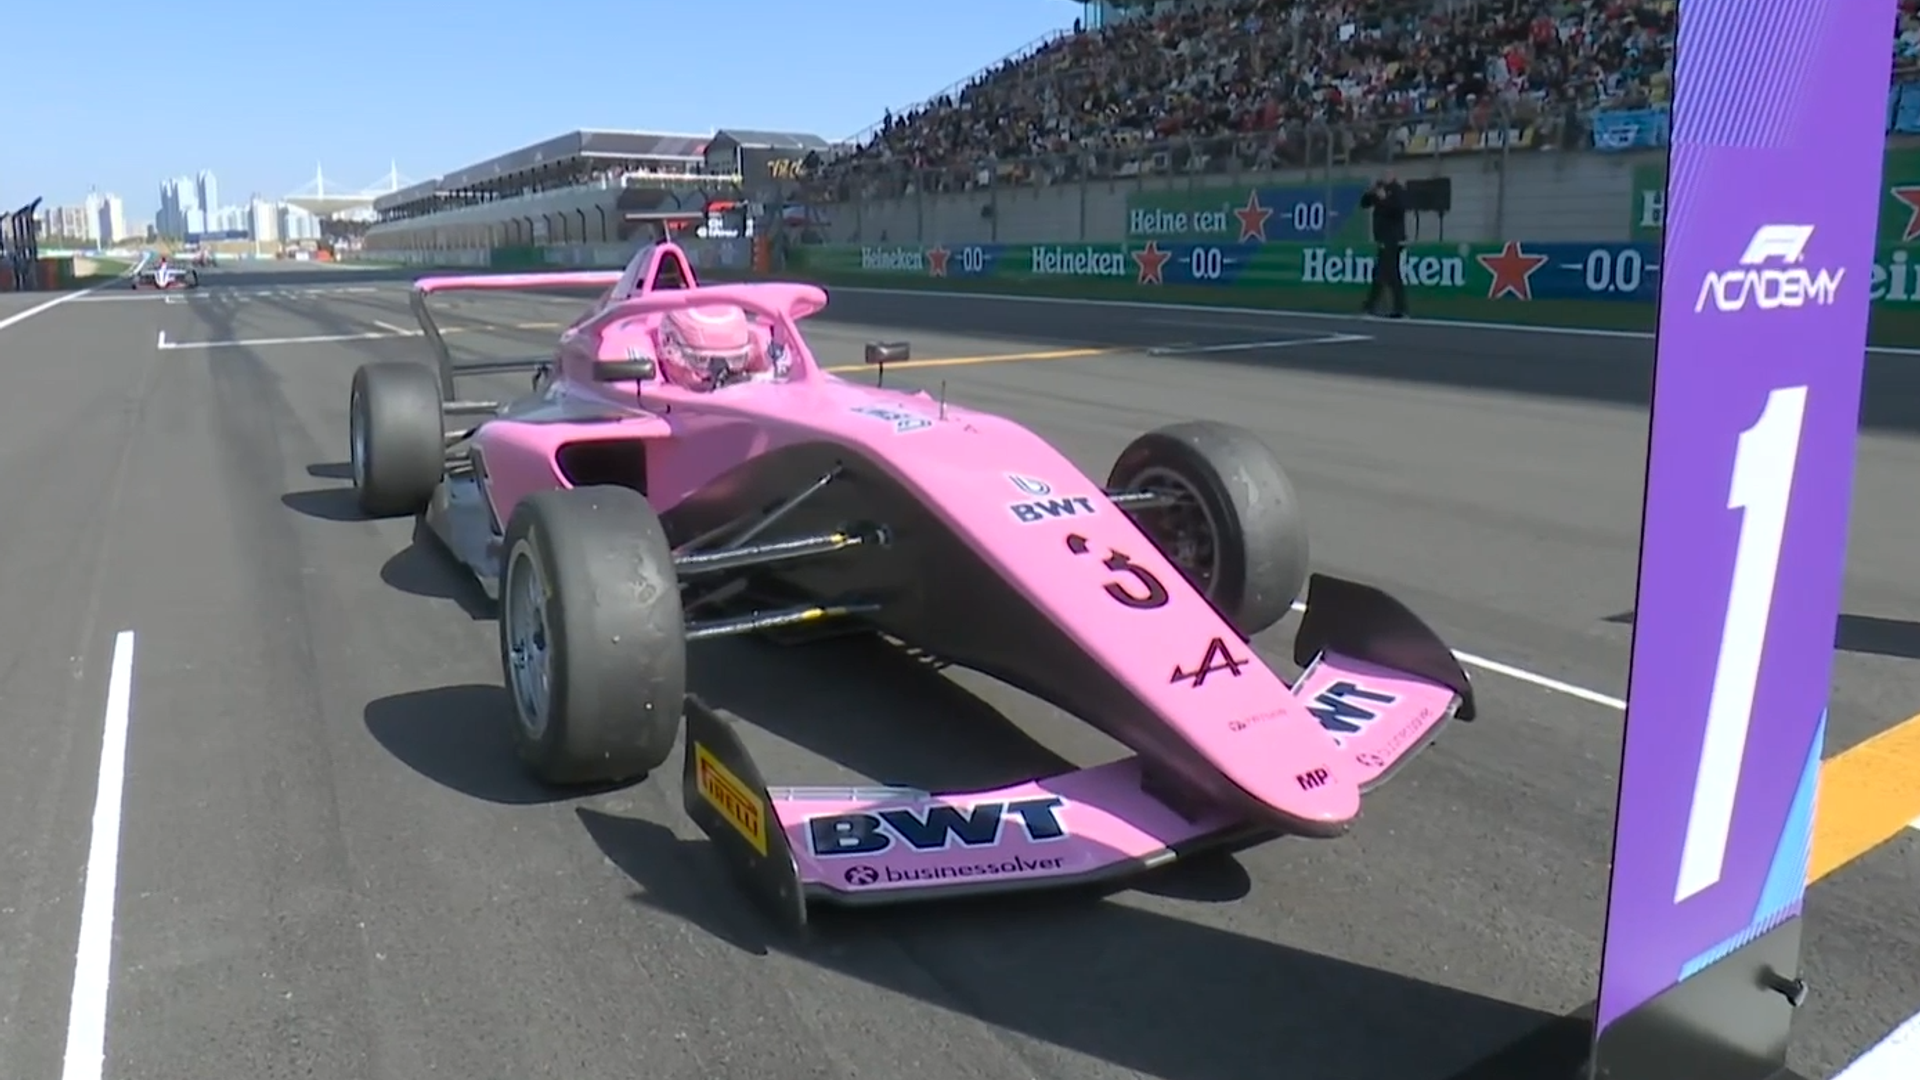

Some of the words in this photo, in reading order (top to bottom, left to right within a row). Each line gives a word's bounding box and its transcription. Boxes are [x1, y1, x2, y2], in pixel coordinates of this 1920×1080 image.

[861, 246, 924, 271] Heineken
[1031, 246, 1126, 276] Heineken
[1739, 223, 1815, 265] F1
[1301, 248, 1466, 287] Heinken
[1694, 266, 1846, 313] ACADEMY
[1010, 497, 1096, 523] BWT
[1674, 385, 1809, 904] 1
[1305, 680, 1397, 746] WT
[701, 757, 759, 838] PIRELLI
[1296, 768, 1329, 791] MP
[807, 796, 1067, 856] BWT
[886, 854, 1064, 882] businessolver
